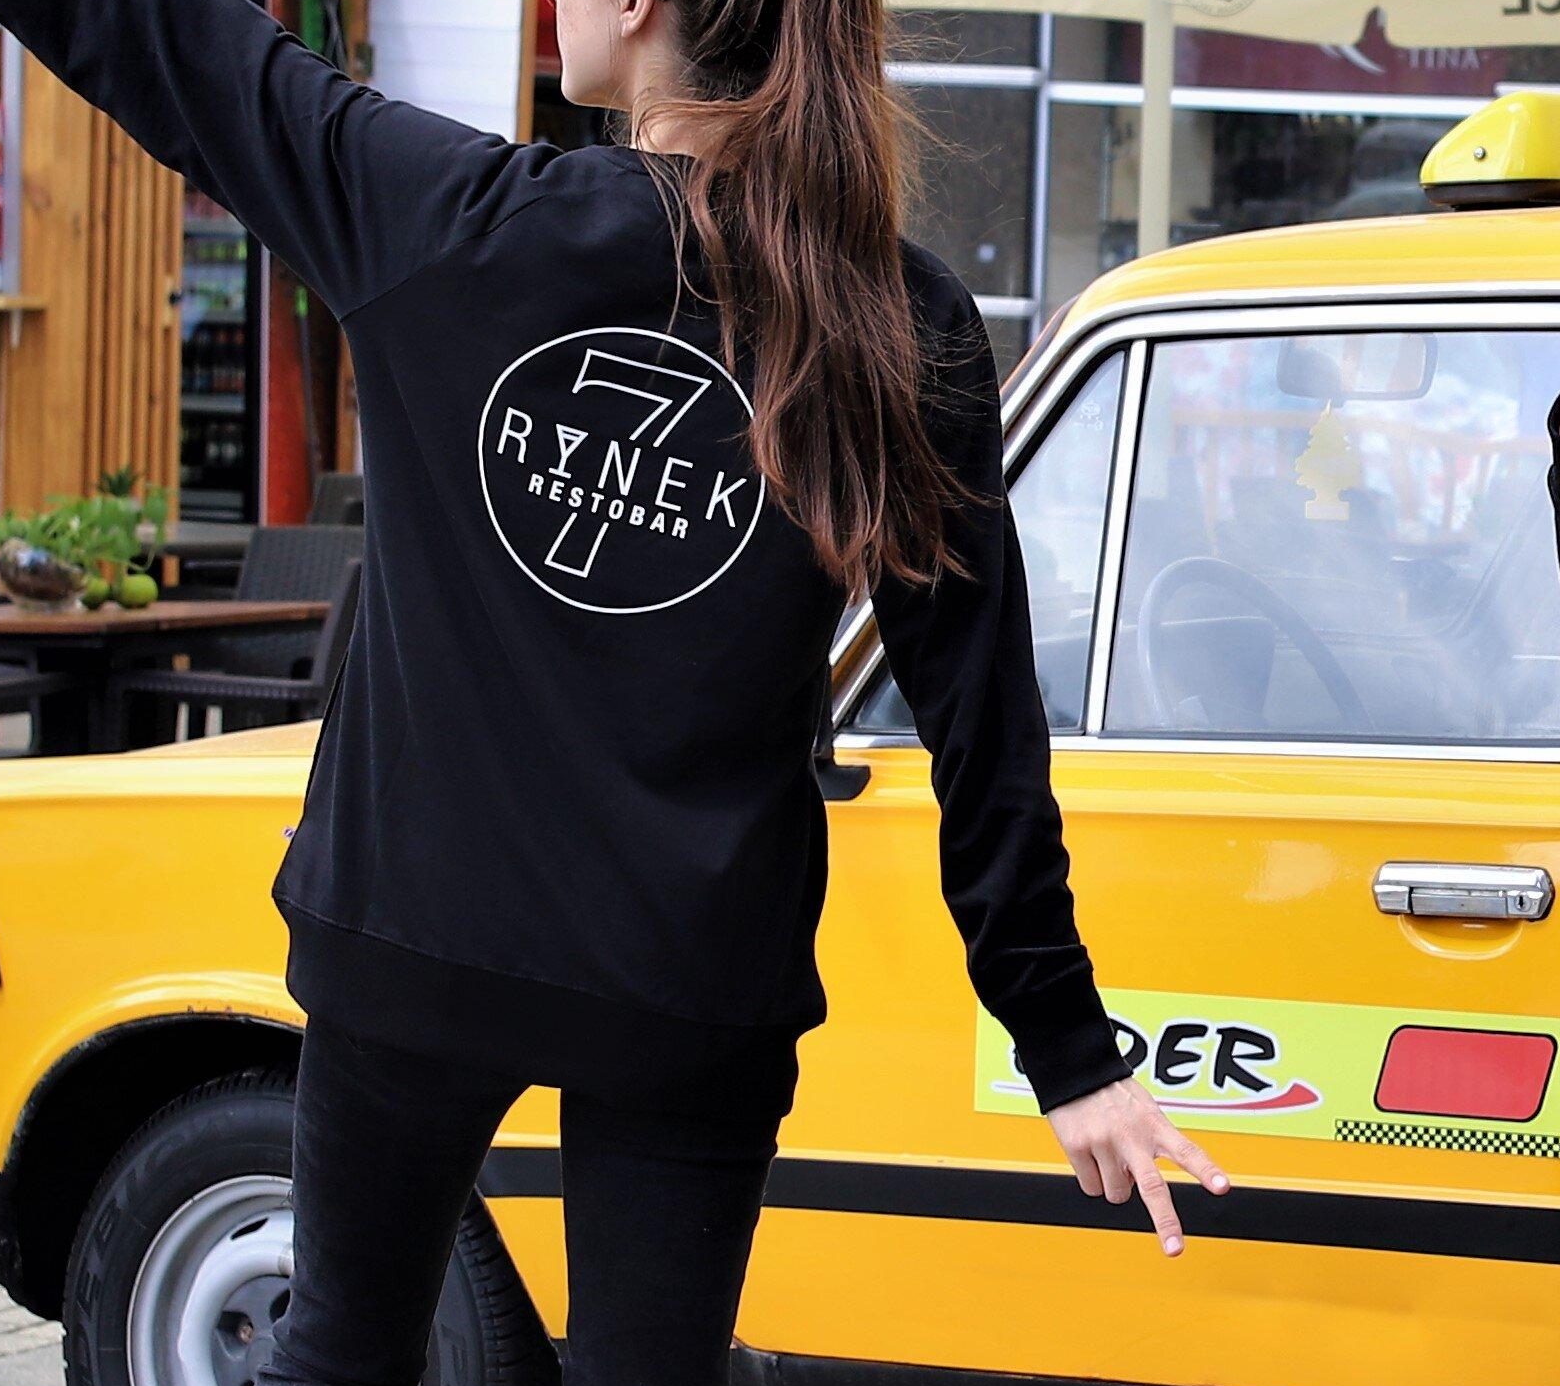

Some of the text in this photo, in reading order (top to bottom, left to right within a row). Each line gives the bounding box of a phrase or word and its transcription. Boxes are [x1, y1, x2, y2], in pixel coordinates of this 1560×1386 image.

[497, 407, 746, 528] RYNEK
[528, 473, 689, 539] RESTOBAR
[1014, 1017, 1275, 1092] DER
